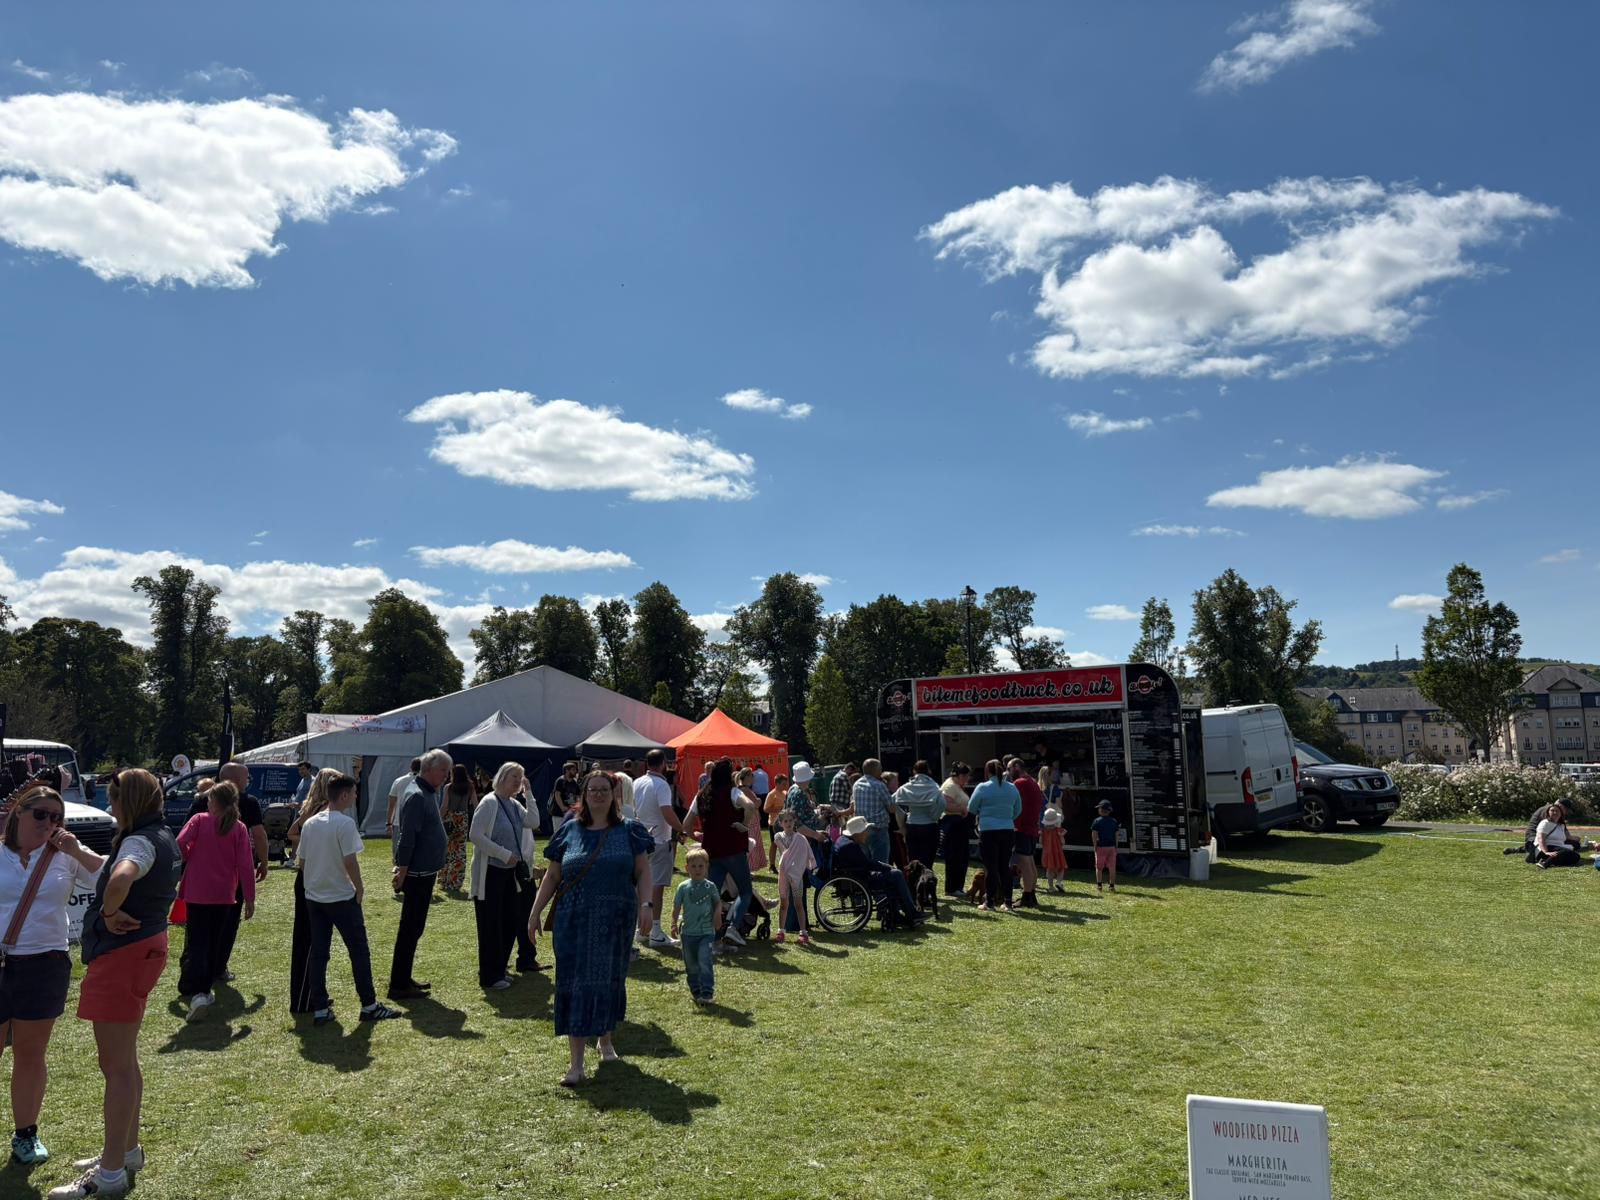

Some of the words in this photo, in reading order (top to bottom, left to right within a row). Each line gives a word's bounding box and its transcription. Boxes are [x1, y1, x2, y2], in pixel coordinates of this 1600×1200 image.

[1213, 1119, 1268, 1141] WOODFIRED
[1271, 1124, 1300, 1144] PIZZA
[1227, 1153, 1288, 1172] MARGHERITA
